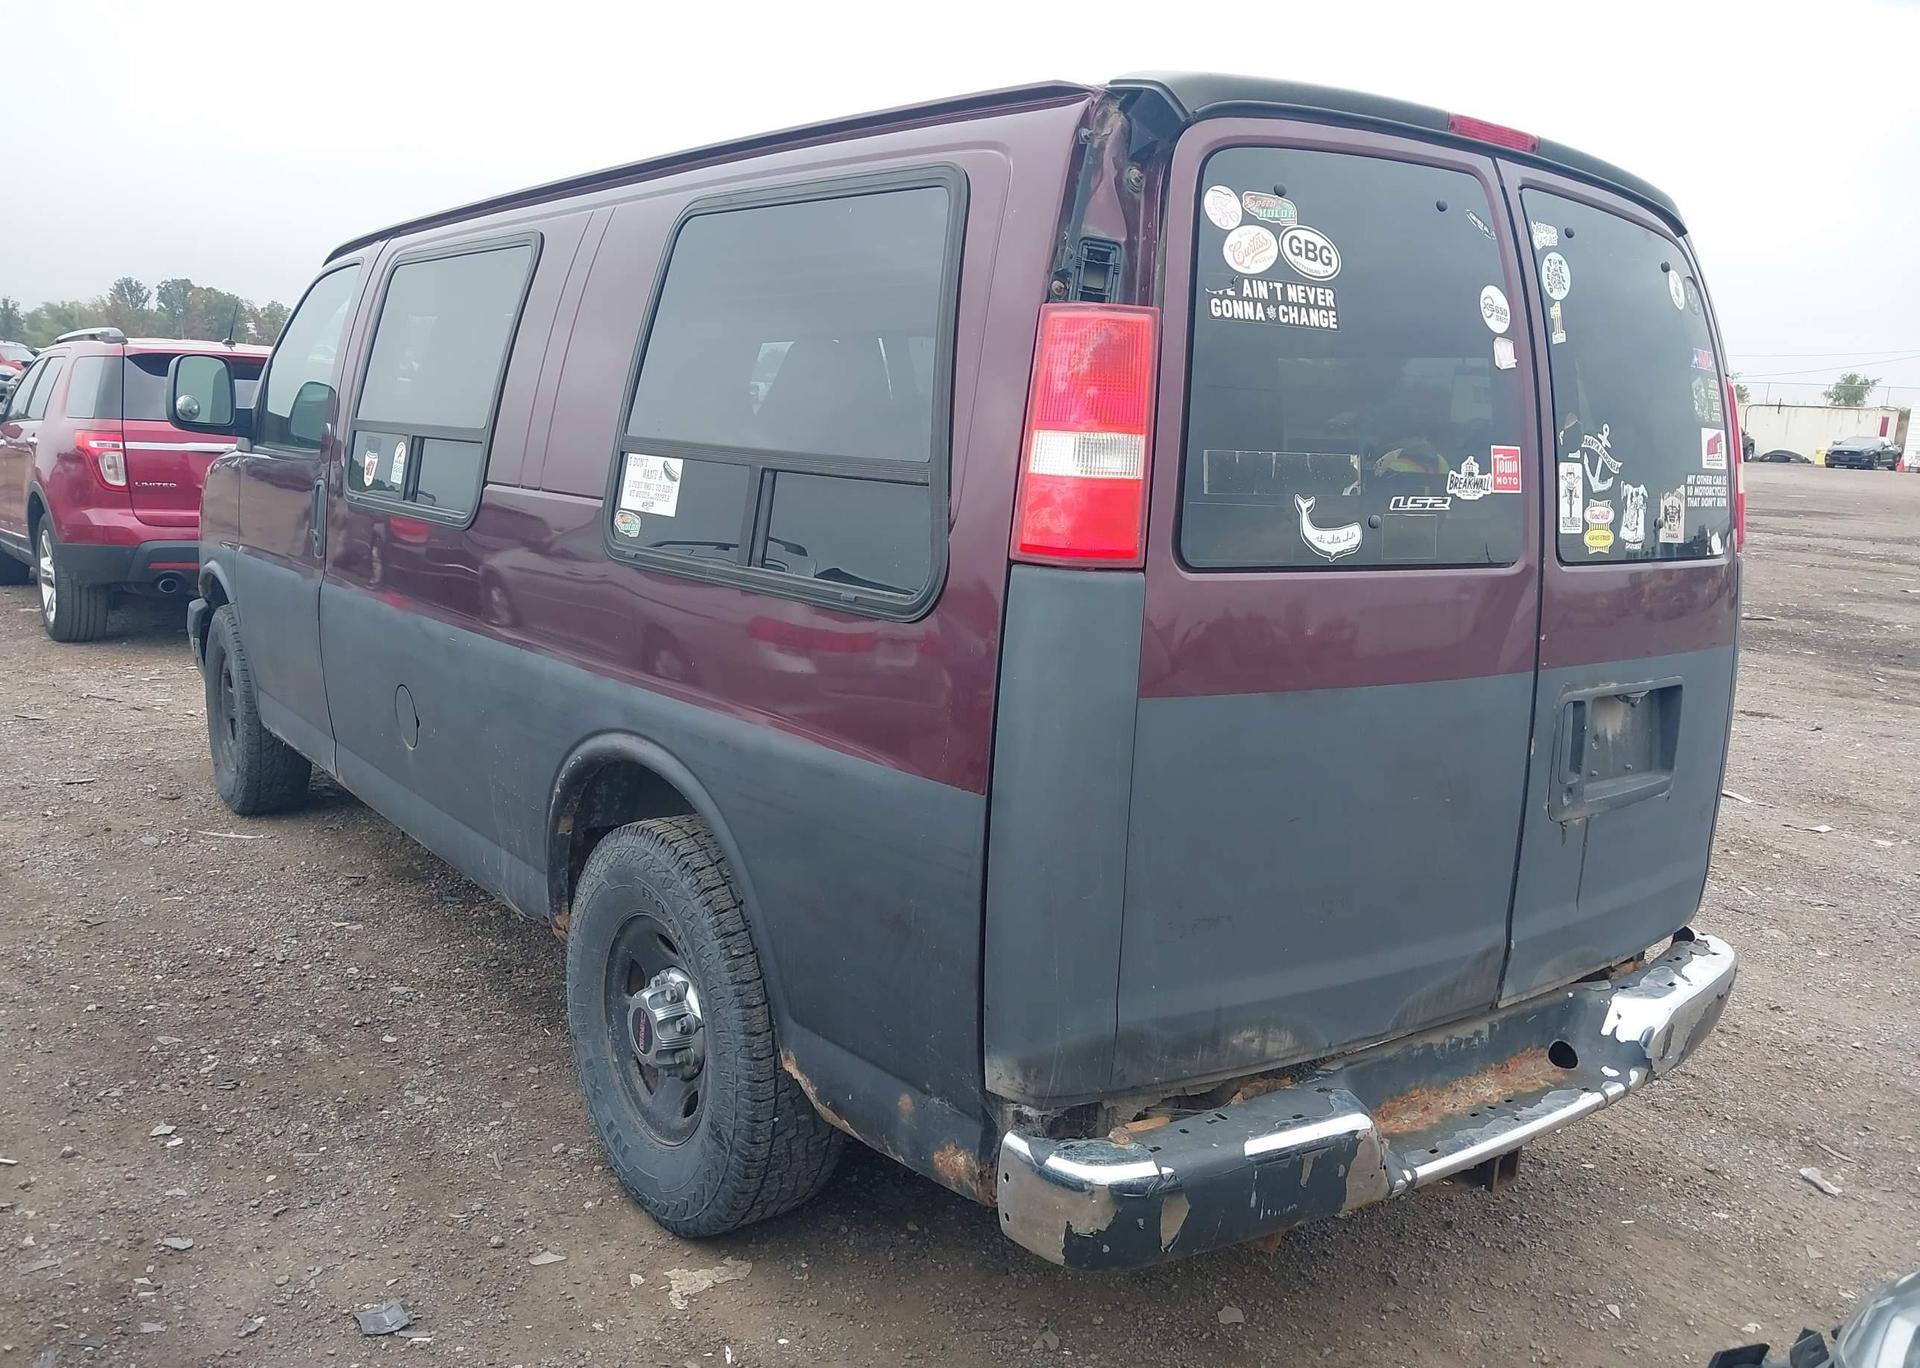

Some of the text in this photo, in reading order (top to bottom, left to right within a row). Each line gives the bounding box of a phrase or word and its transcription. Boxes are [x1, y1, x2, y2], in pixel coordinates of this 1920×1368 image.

[1288, 235, 1334, 268] GBG
[1242, 279, 1284, 300] AIN'T
[1287, 283, 1336, 308] NEVER
[1210, 298, 1338, 329] GONNA CHANGE
[1496, 476, 1518, 485] MOTO
[1687, 475, 1696, 485] MY
[1696, 475, 1712, 485] OTHER
[1712, 475, 1722, 485] CAR
[1687, 497, 1700, 508] THAT
[1700, 498, 1716, 507] DON'T
